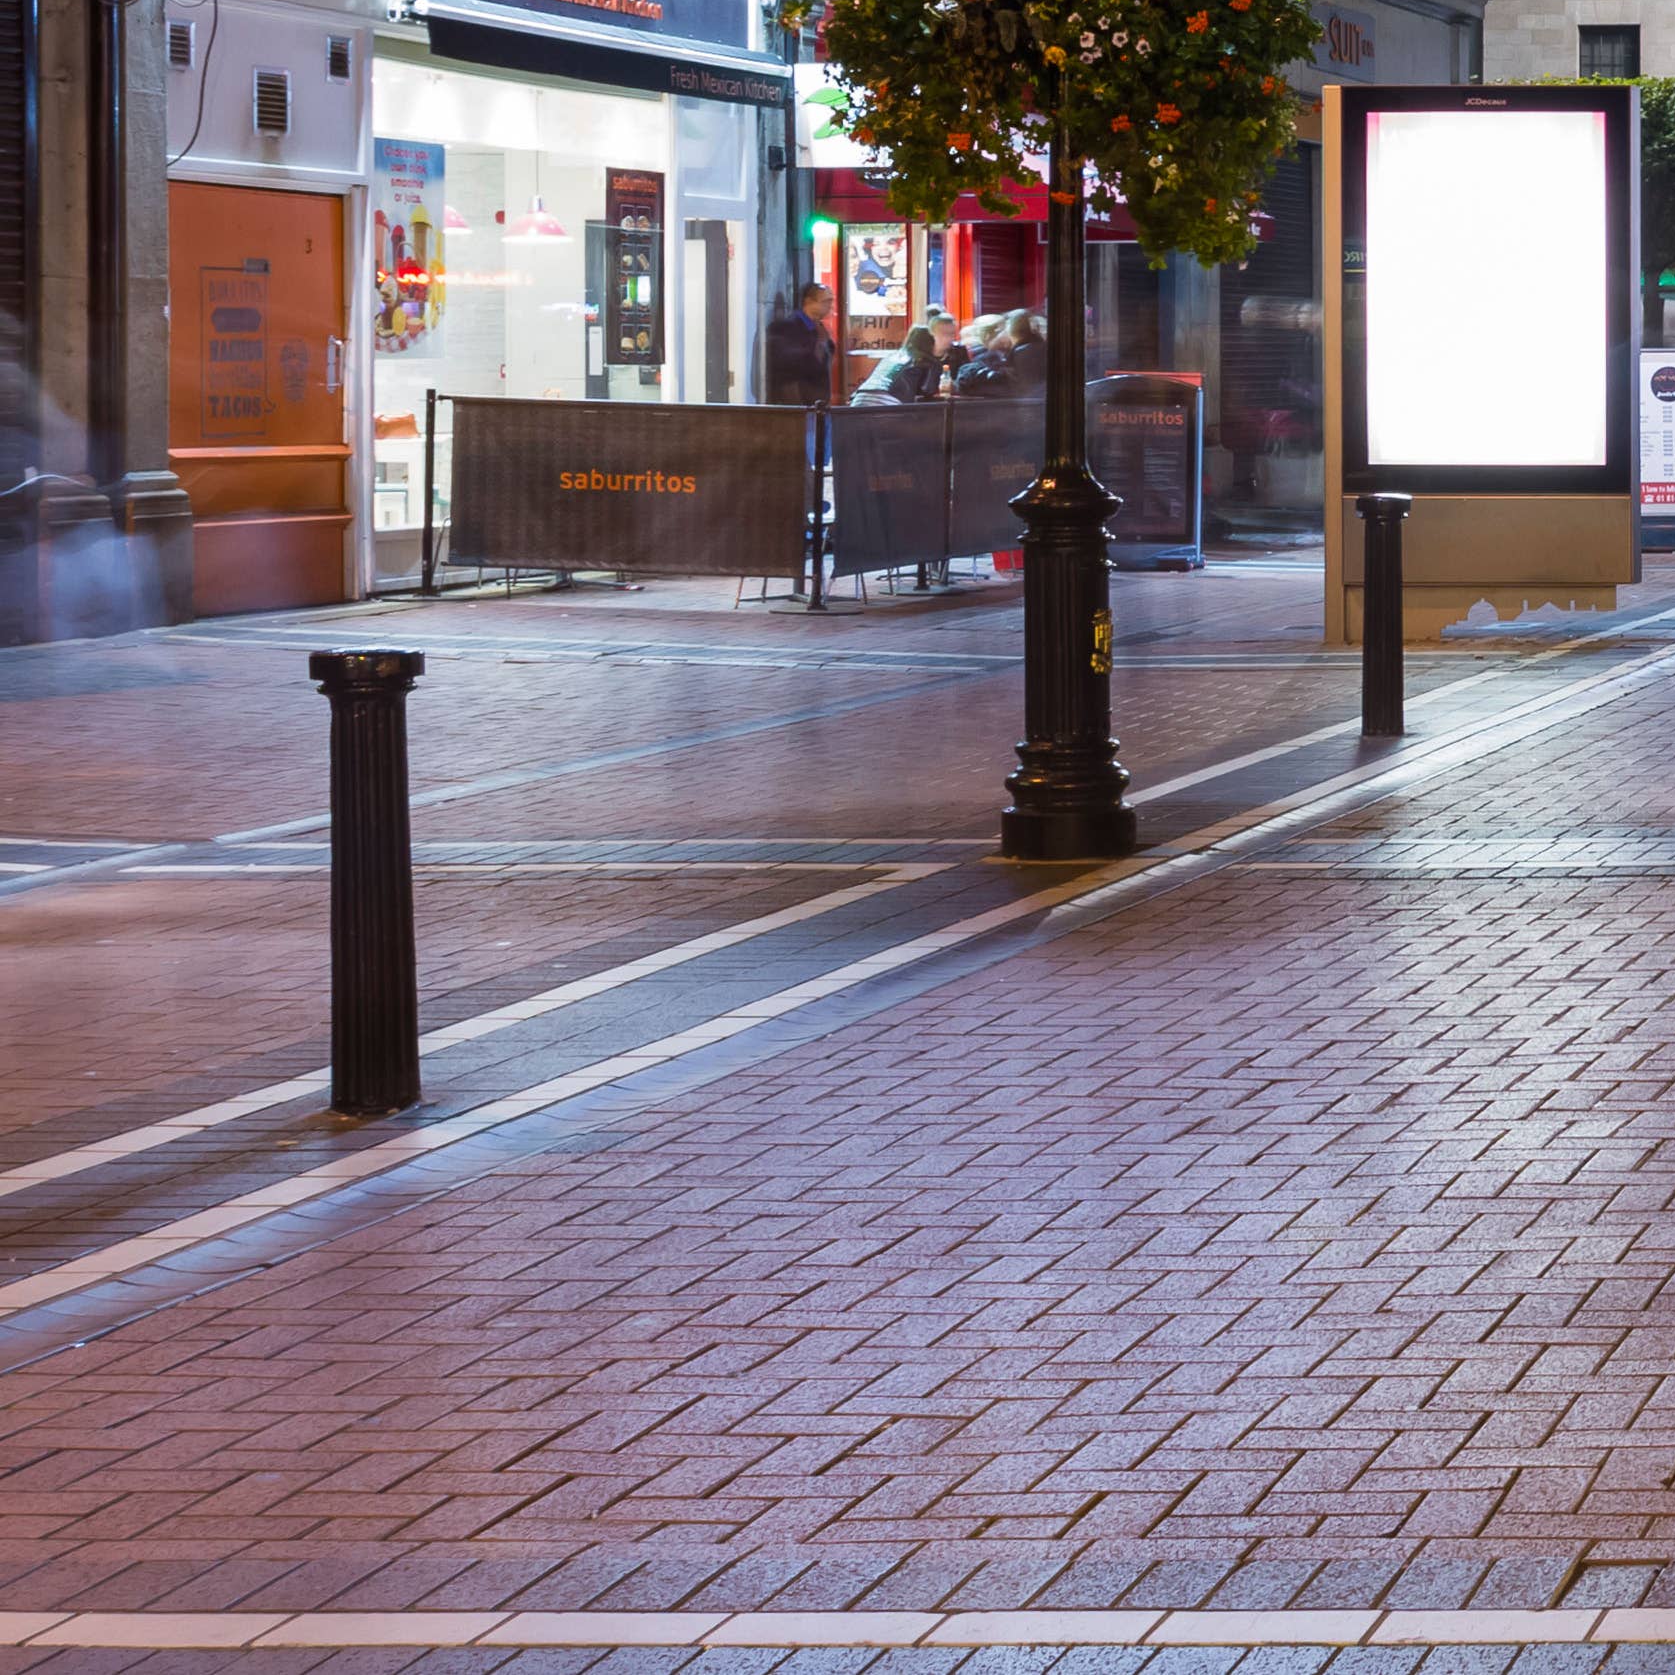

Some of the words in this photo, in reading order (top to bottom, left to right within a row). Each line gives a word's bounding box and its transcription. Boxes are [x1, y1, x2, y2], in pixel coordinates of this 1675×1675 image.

[1328, 16, 1364, 66] SUIT
[670, 65, 698, 90] Fresh
[701, 70, 743, 96] Mexican
[745, 77, 782, 101] Kitchen
[559, 468, 697, 493] saburritos
